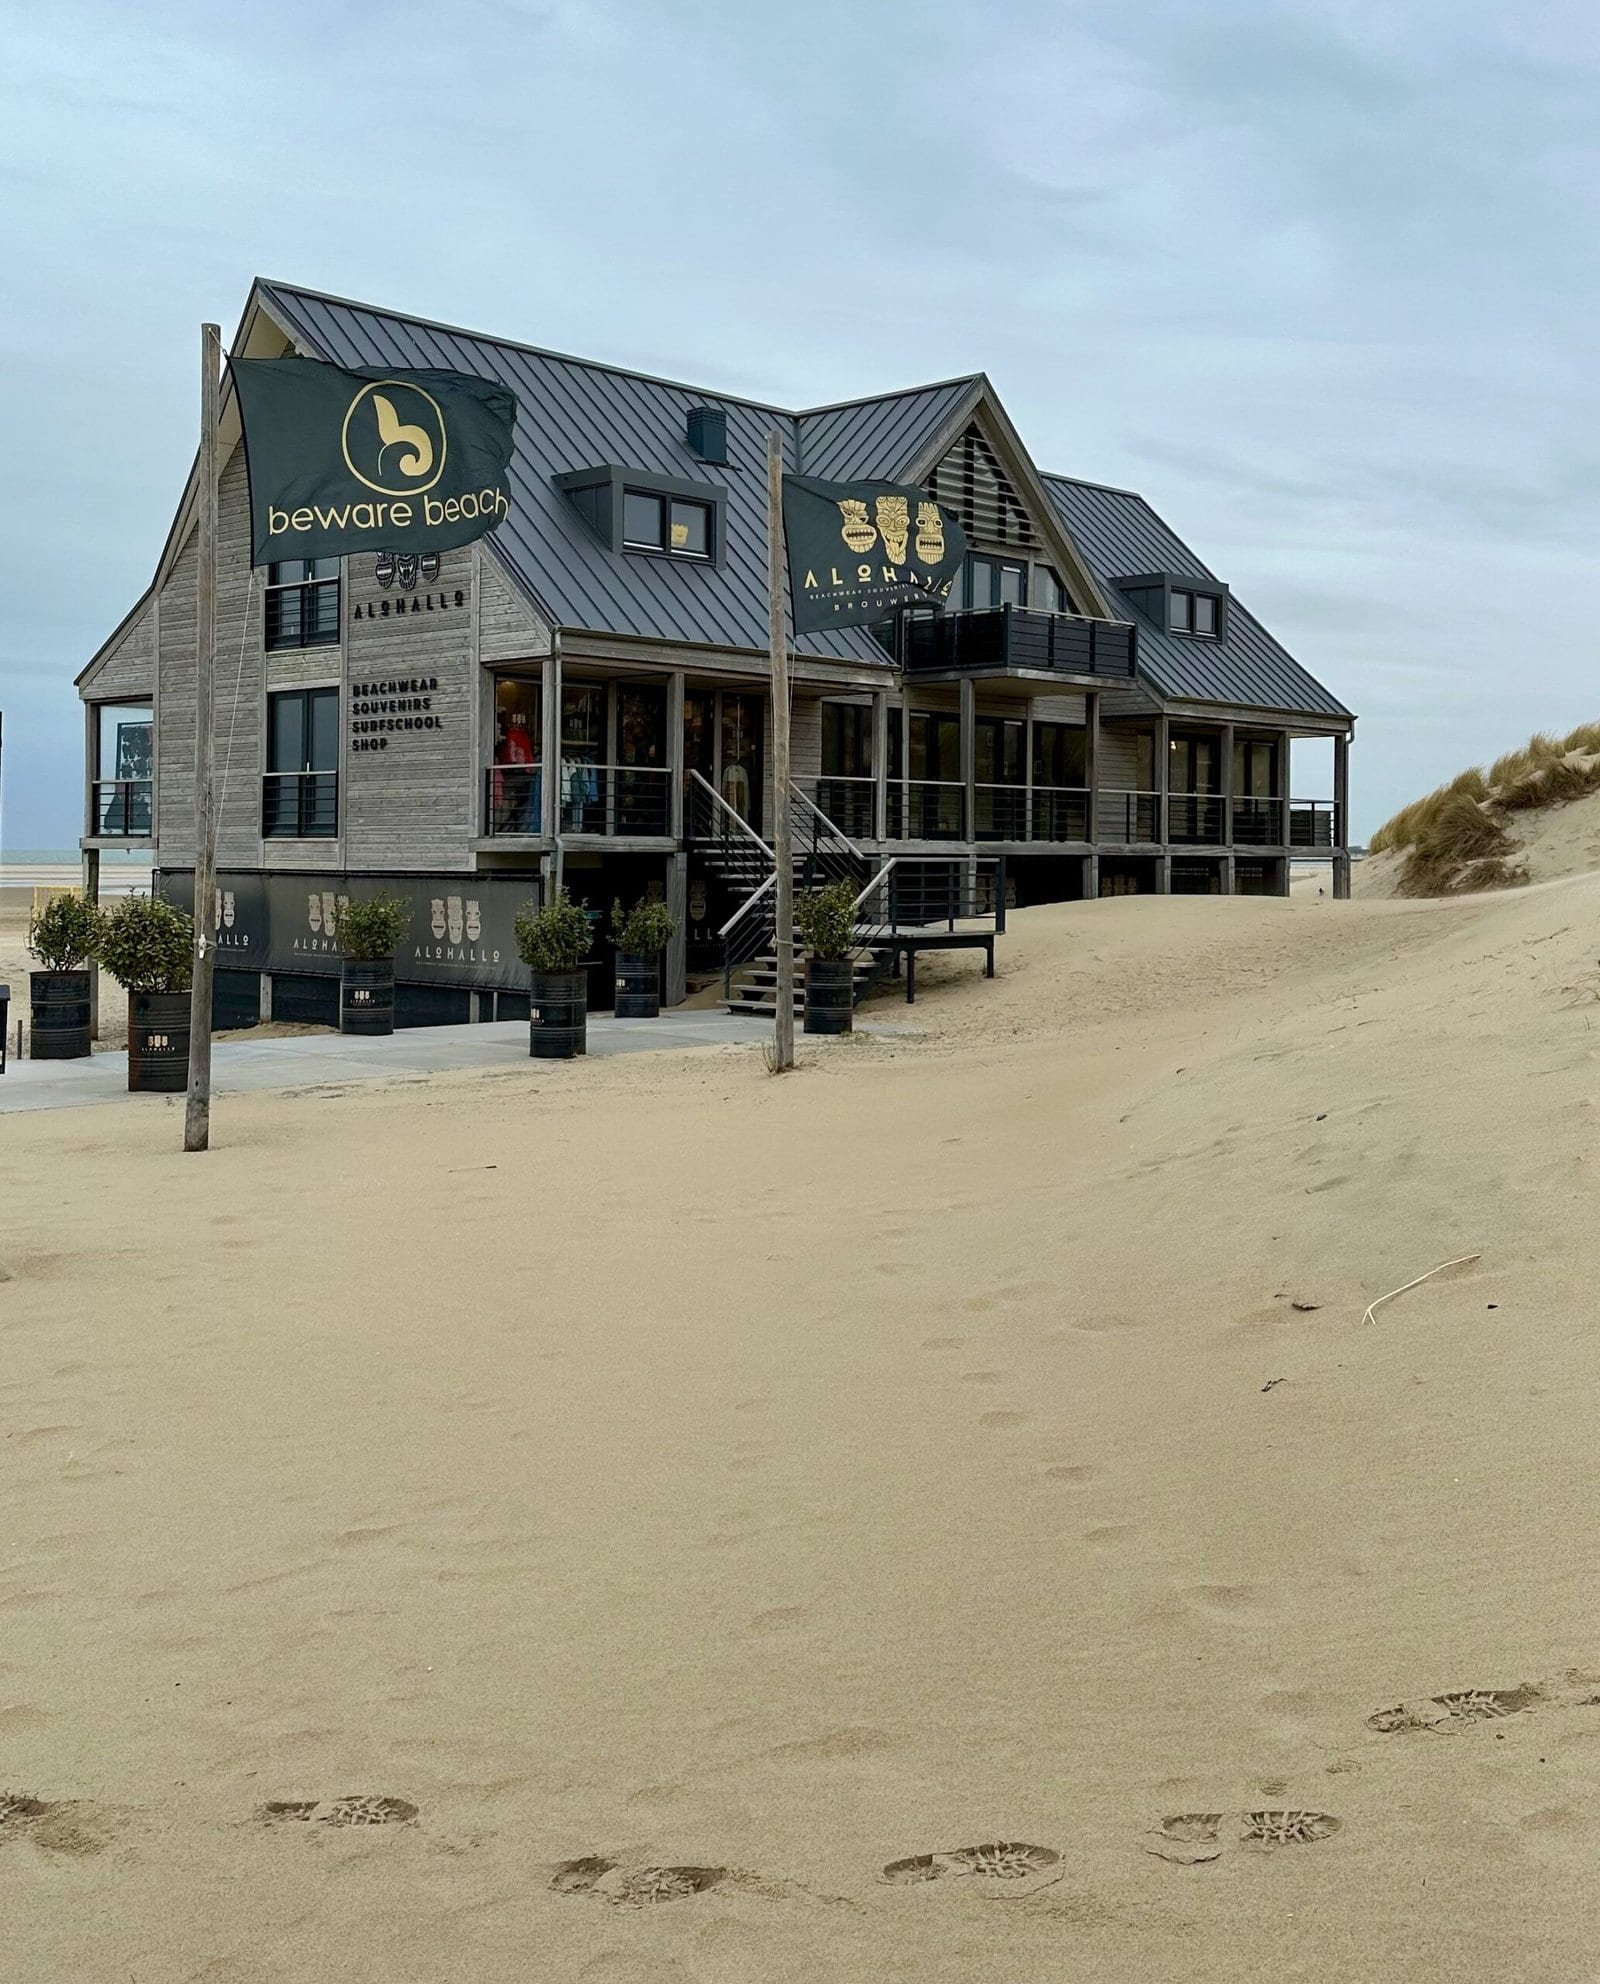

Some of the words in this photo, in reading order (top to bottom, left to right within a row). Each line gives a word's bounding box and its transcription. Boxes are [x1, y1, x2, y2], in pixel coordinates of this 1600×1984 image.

[269, 502, 412, 535] beware
[424, 487, 509, 527] beach
[354, 590, 464, 619] ALOHALLO
[352, 678, 438, 697] BEACHWEAR
[352, 698, 431, 715] SOUVENIRS
[352, 716, 442, 733] SURFSCHOOL
[352, 737, 388, 751] SHOP
[414, 945, 500, 963] ALOHALLO
